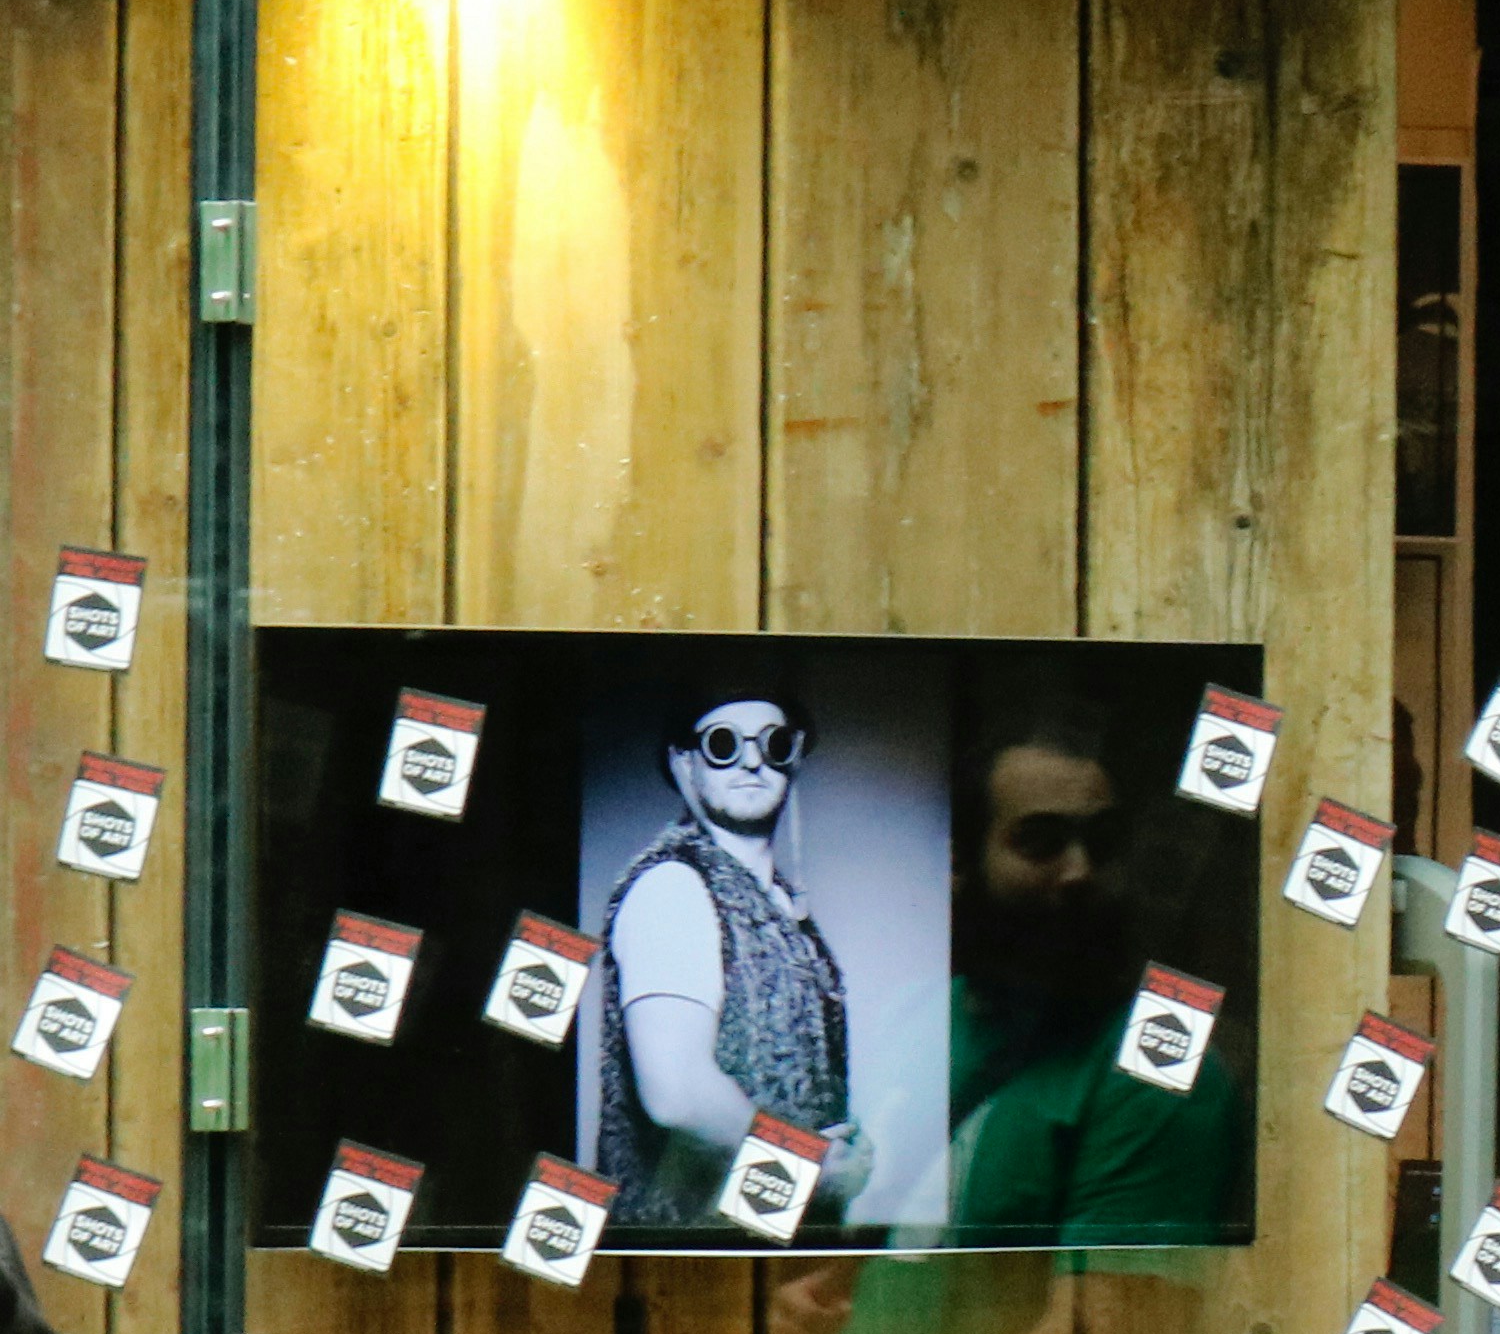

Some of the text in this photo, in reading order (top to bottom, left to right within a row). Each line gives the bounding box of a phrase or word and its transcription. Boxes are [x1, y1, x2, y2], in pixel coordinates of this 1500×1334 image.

[67, 604, 120, 625] SHOTS
[66, 619, 118, 639] OF ART
[406, 747, 454, 771] SHOTS
[1206, 742, 1253, 768] SHOTS
[403, 763, 452, 784] OF ART
[1203, 757, 1250, 781] OF ART
[83, 809, 134, 834] SHOTS
[80, 825, 132, 847] OF ART
[1307, 867, 1354, 894] OF ART
[1312, 853, 1358, 882] SHOTS
[1467, 899, 1486, 914] OF
[338, 969, 388, 994] SHOTS
[516, 970, 563, 998] SHOTS
[334, 985, 385, 1008] OF ART
[511, 985, 559, 1011] OF ART
[45, 1004, 94, 1033] SHOTS
[39, 1018, 90, 1046] OF ART
[1144, 1020, 1190, 1047] SHOTS
[1140, 1034, 1186, 1060] OF ART
[1348, 1079, 1394, 1107] OF ART
[1354, 1065, 1398, 1095] SHOTS
[748, 1166, 793, 1195] SHOTS
[742, 1180, 789, 1208] OF ART
[339, 1200, 387, 1227] SHOTS
[534, 1212, 581, 1241] SHOTS
[75, 1213, 125, 1241] SHOTS
[334, 1215, 384, 1240] OF ART
[70, 1228, 121, 1255] OF ART
[528, 1227, 577, 1254] OF ART
[1476, 1249, 1496, 1264] OF
